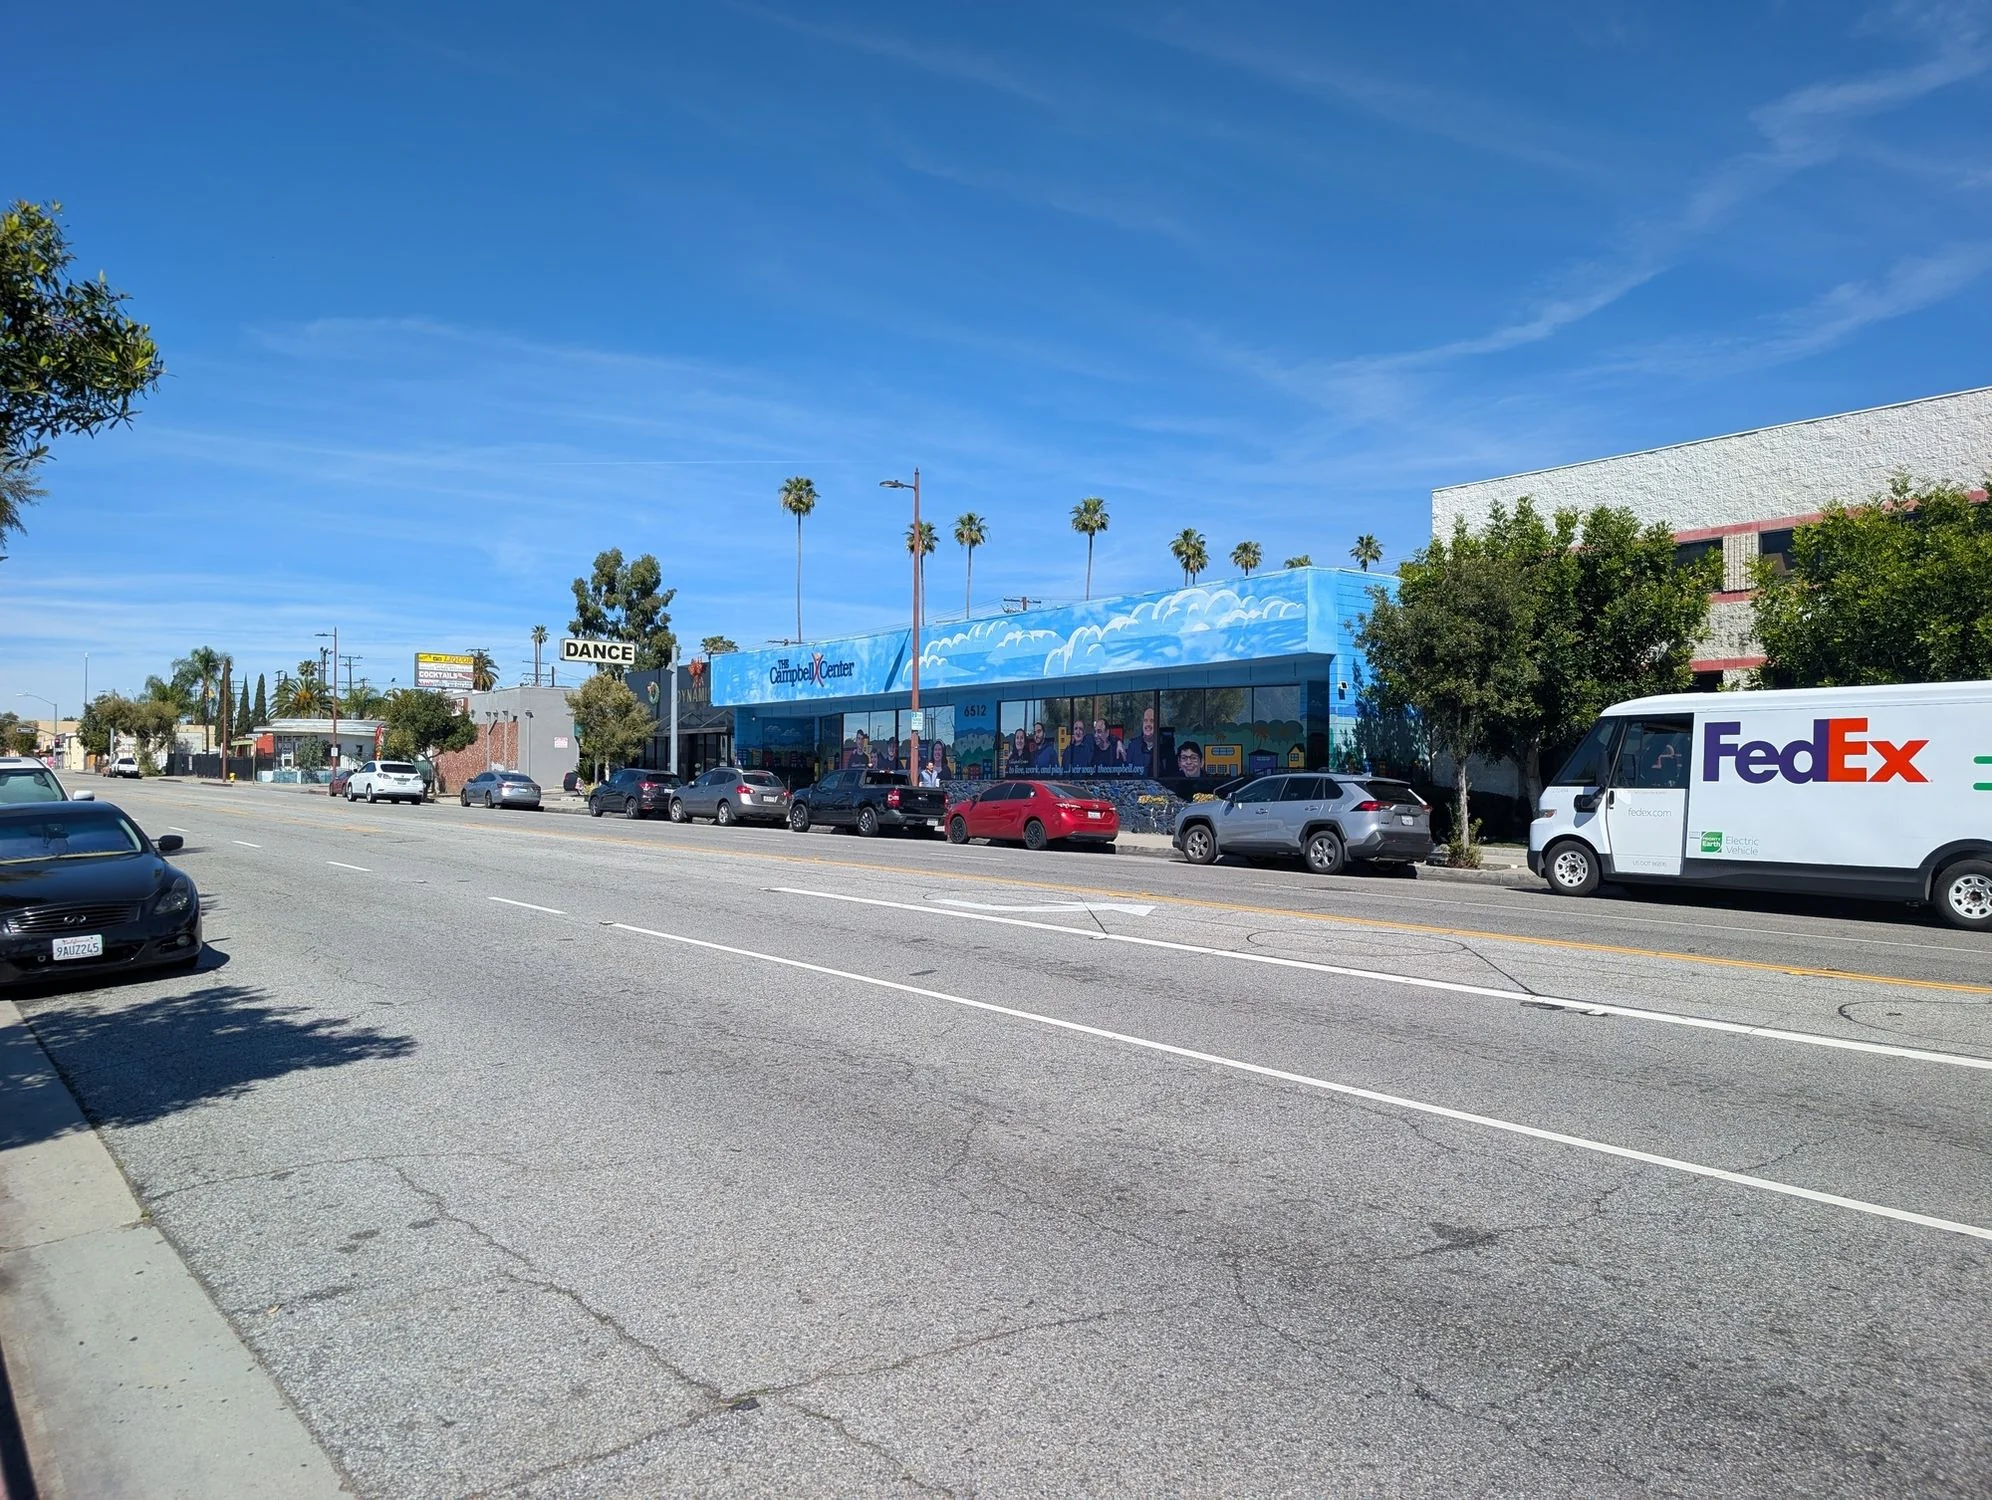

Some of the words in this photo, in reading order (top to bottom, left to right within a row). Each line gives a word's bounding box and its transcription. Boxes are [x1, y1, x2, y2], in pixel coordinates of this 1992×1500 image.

[566, 642, 632, 661] DANCE
[443, 655, 473, 664] LIQUOR
[778, 659, 789, 669] THE
[419, 671, 458, 679] COCKTAILS
[770, 662, 814, 687] Campbell
[820, 660, 855, 679] Center
[964, 704, 987, 717] 6512
[1703, 717, 1930, 784] FedEx
[1628, 808, 1672, 818] fedex.com
[1725, 836, 1760, 846] Electric
[1726, 846, 1759, 855] Vehicle
[57, 943, 100, 957] 9AUZ245
